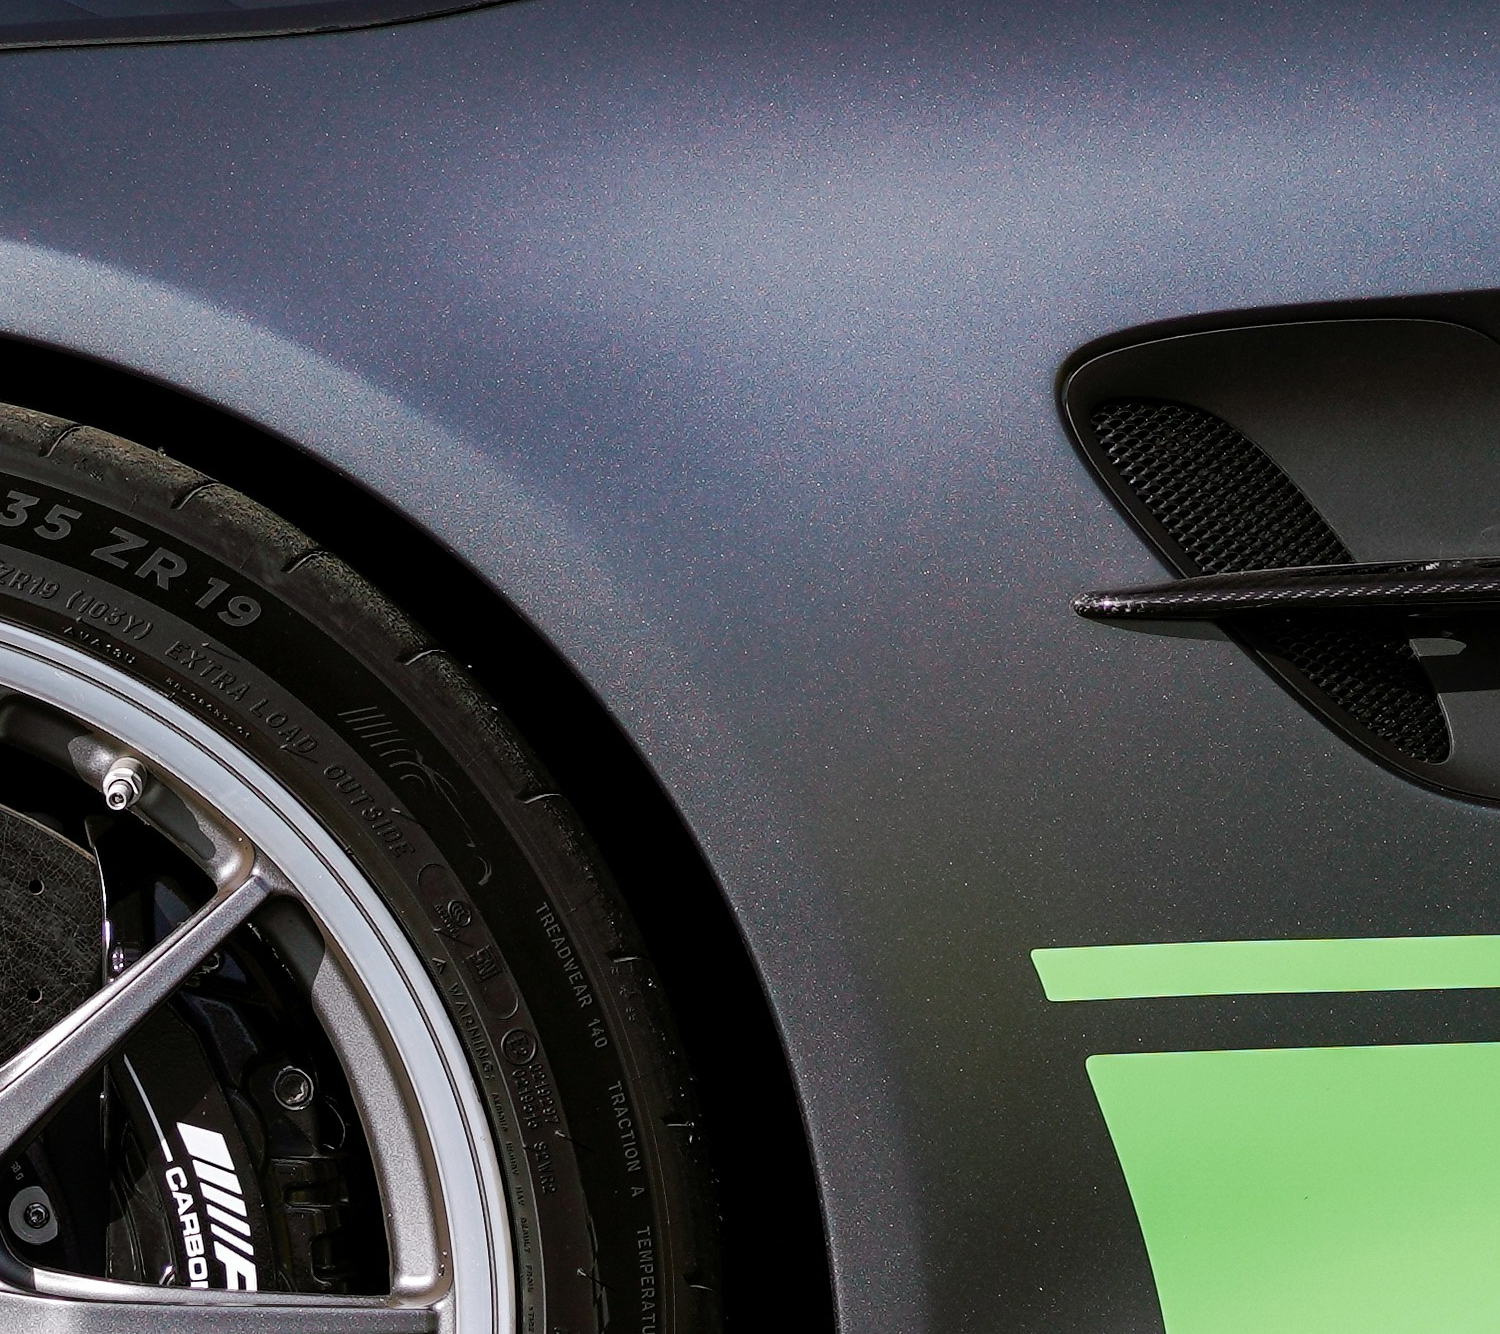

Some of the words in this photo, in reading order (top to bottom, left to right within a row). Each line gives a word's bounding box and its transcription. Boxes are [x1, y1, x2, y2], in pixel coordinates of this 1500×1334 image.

[87, 523, 193, 589] ZR
[189, 570, 267, 638] 19
[163, 639, 253, 700] EXTRA
[248, 698, 320, 755] LOAD
[320, 763, 416, 857] OUTSIDE
[530, 898, 596, 1012] TREADWEAR
[583, 1014, 611, 1051] 140
[604, 1078, 643, 1174] TRACTION
[628, 1182, 647, 1199] A
